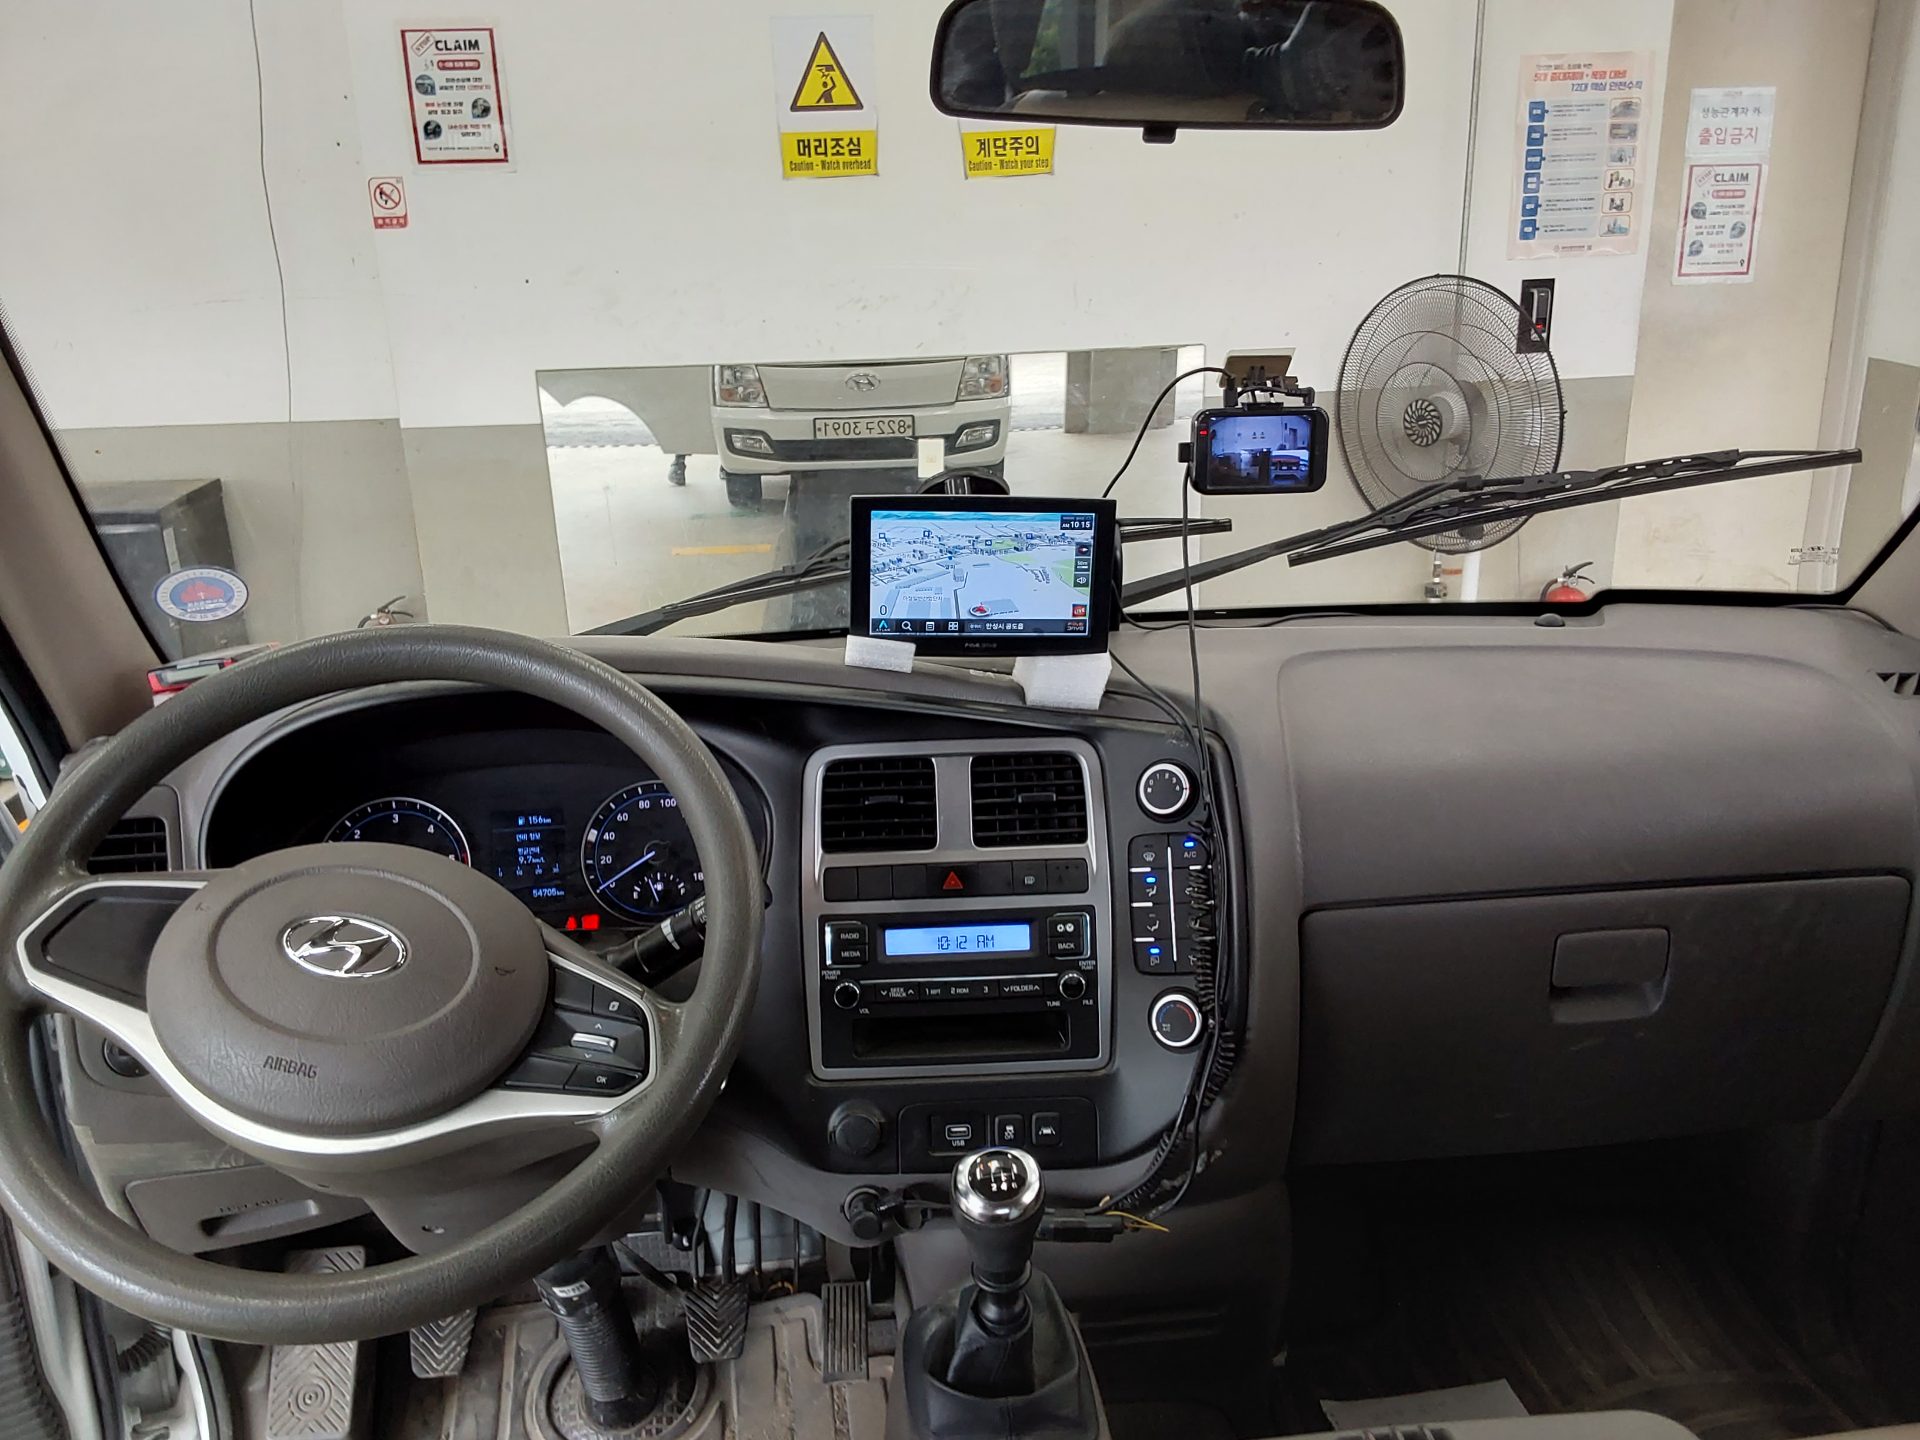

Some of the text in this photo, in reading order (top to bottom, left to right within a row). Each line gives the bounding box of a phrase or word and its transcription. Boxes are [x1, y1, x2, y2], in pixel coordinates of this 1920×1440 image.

[435, 39, 480, 51] CLAIM
[1571, 80, 1643, 92] 12대 핵심 안전수칙
[1698, 126, 1758, 146] 출입금지
[797, 137, 861, 158] 머리조심
[976, 136, 1039, 158] 계단주의
[789, 160, 814, 172] Caution
[821, 159, 841, 170] Watch
[842, 158, 872, 170] overhead
[969, 160, 992, 172] Caution
[999, 158, 1019, 170] Watch
[1020, 159, 1034, 170] your
[1035, 158, 1049, 168] step
[1714, 173, 1749, 183] CLAIM
[880, 604, 888, 615] 0
[638, 799, 650, 809] 80
[660, 798, 677, 808] 100
[392, 813, 399, 824] 3
[616, 812, 629, 822] 60
[354, 829, 361, 839] 2
[427, 824, 434, 834] 4
[603, 831, 616, 841] 40
[600, 855, 612, 865] 20
[693, 871, 704, 881] 18
[977, 934, 995, 949] AM
[263, 1055, 318, 1079] AIRBAG
[596, 1075, 608, 1084] OK
[991, 1182, 997, 1192] 2
[1000, 1182, 1008, 1191] 4
